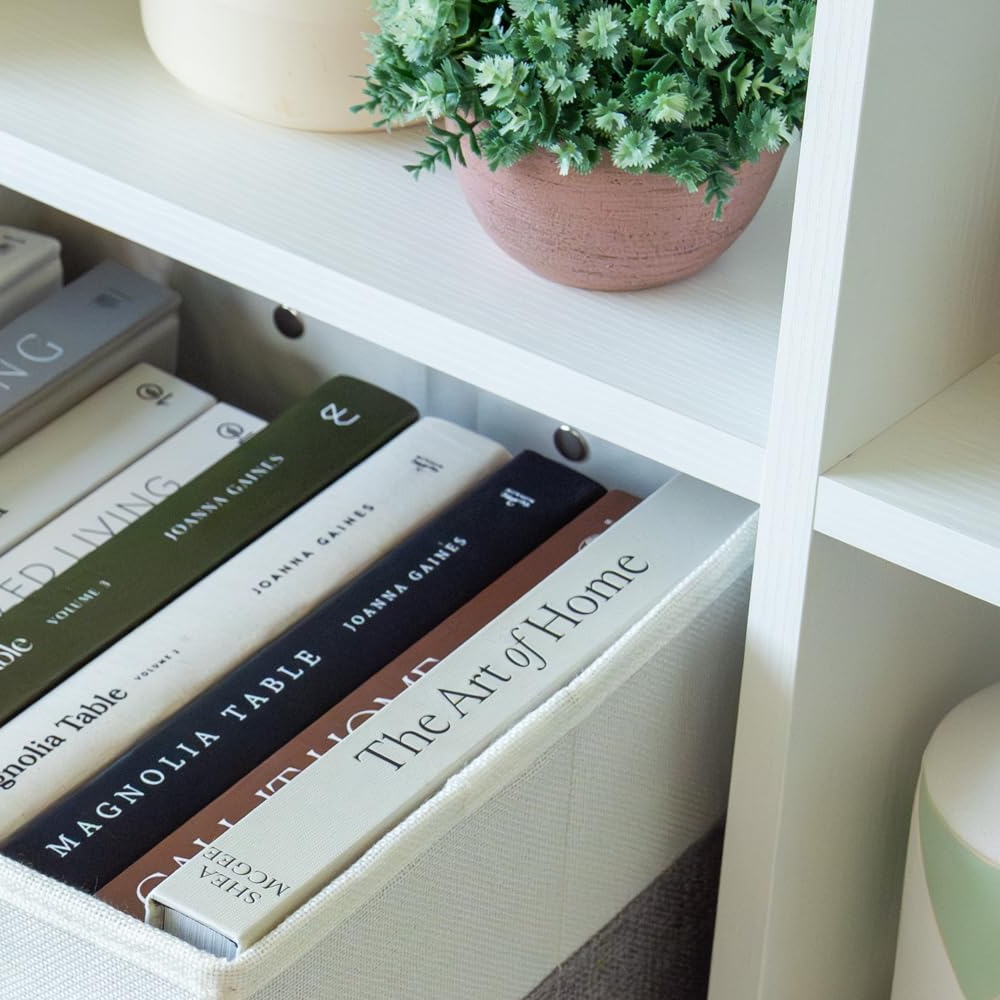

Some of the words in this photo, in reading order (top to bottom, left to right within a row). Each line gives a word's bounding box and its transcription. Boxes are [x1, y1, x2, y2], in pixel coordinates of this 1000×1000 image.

[163, 494, 229, 542] JOANNA
[225, 453, 285, 496] GAINES
[252, 550, 314, 596] JOANNA
[317, 502, 375, 546] GAINES
[46, 588, 101, 625] VOLUME
[342, 583, 409, 633] JOANNA
[407, 535, 468, 583] GAINES
[522, 554, 649, 642] Home
[133, 654, 172, 681] VOLUME
[504, 627, 548, 671] of
[55, 688, 128, 732] Table
[436, 663, 512, 720] Art
[45, 728, 221, 859] MAGNOLIA
[220, 648, 323, 722] TABLE
[353, 714, 451, 772] The
[199, 865, 263, 905] SHEA
[202, 846, 291, 898] MCGEE
